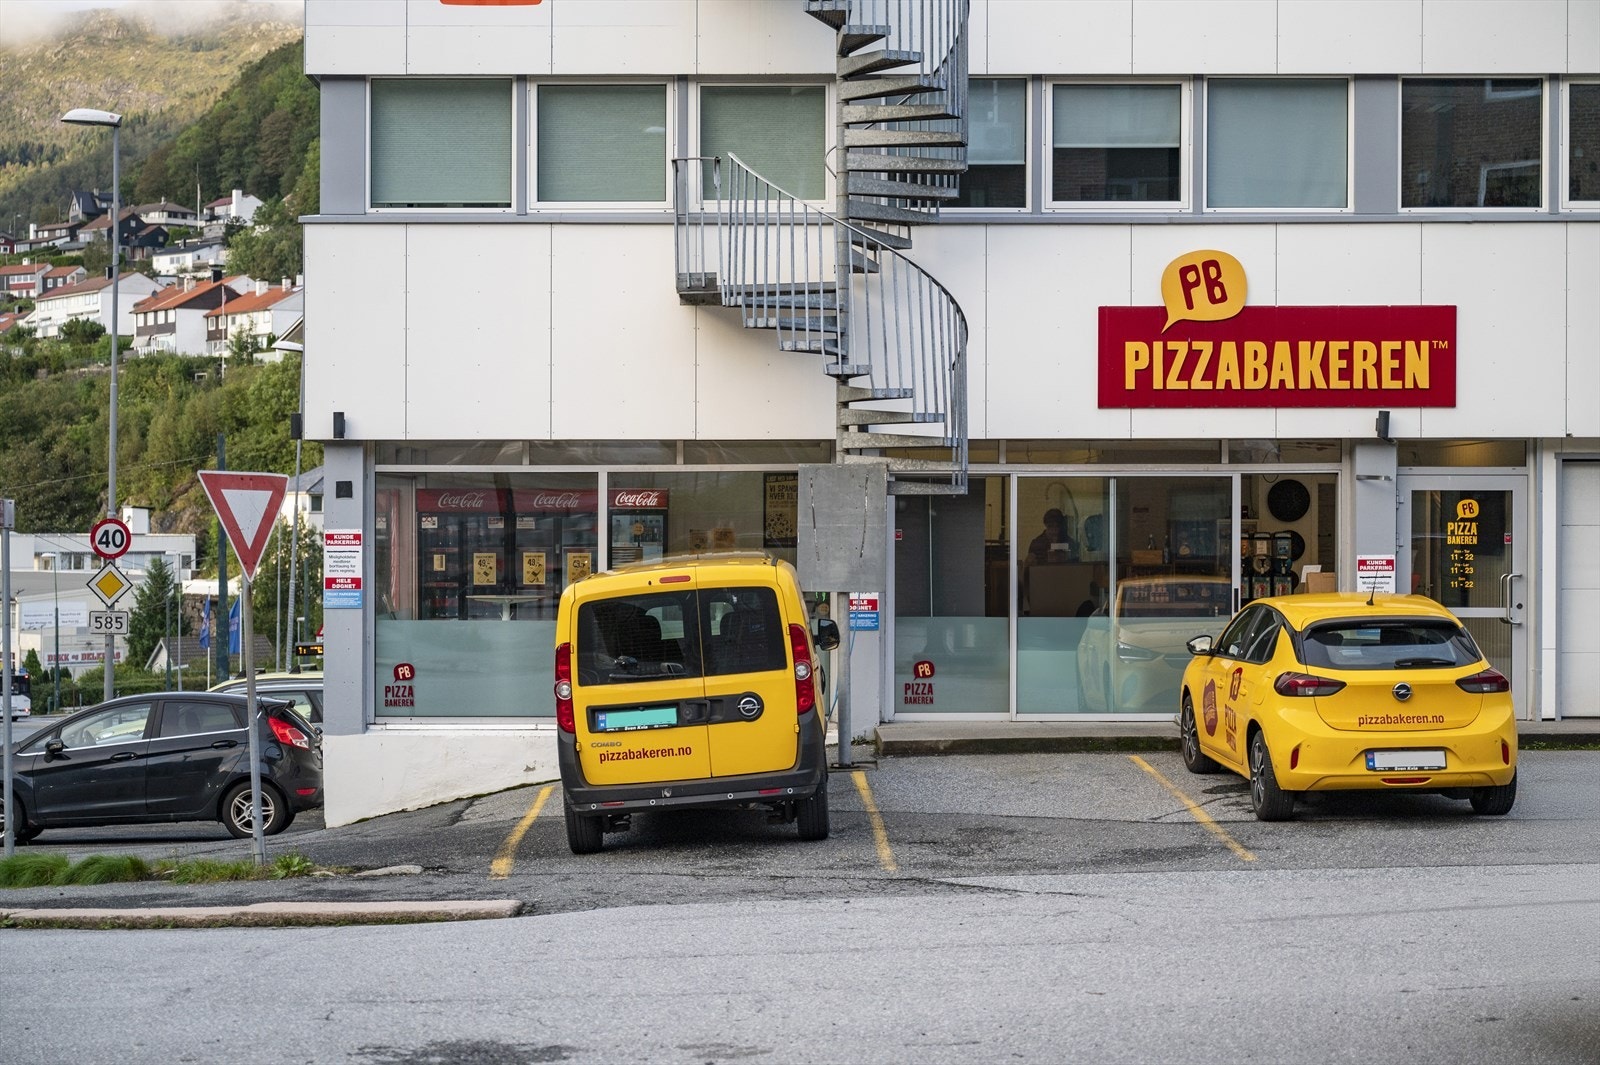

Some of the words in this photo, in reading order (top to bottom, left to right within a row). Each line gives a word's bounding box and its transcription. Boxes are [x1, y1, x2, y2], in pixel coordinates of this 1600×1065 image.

[1178, 259, 1228, 310] PB
[1124, 340, 1429, 390] PIZZABAKEREN
[438, 492, 487, 508] Coca-Cola
[533, 492, 581, 508] Coca-Cola
[615, 491, 659, 506] Coca-Cola
[1462, 502, 1475, 515] PB
[1447, 522, 1477, 535] PIZZA
[98, 529, 125, 548] 40
[1447, 536, 1478, 545] BAKEREN
[94, 616, 123, 629] 585
[398, 665, 411, 680] PB
[918, 663, 931, 677] PB
[385, 685, 414, 698] PIZZA
[904, 683, 933, 695] PIZZA
[384, 699, 415, 707] BAKEREN
[1358, 713, 1444, 727] pizzabakeren.no
[599, 746, 692, 764] pizzabakeren.no
